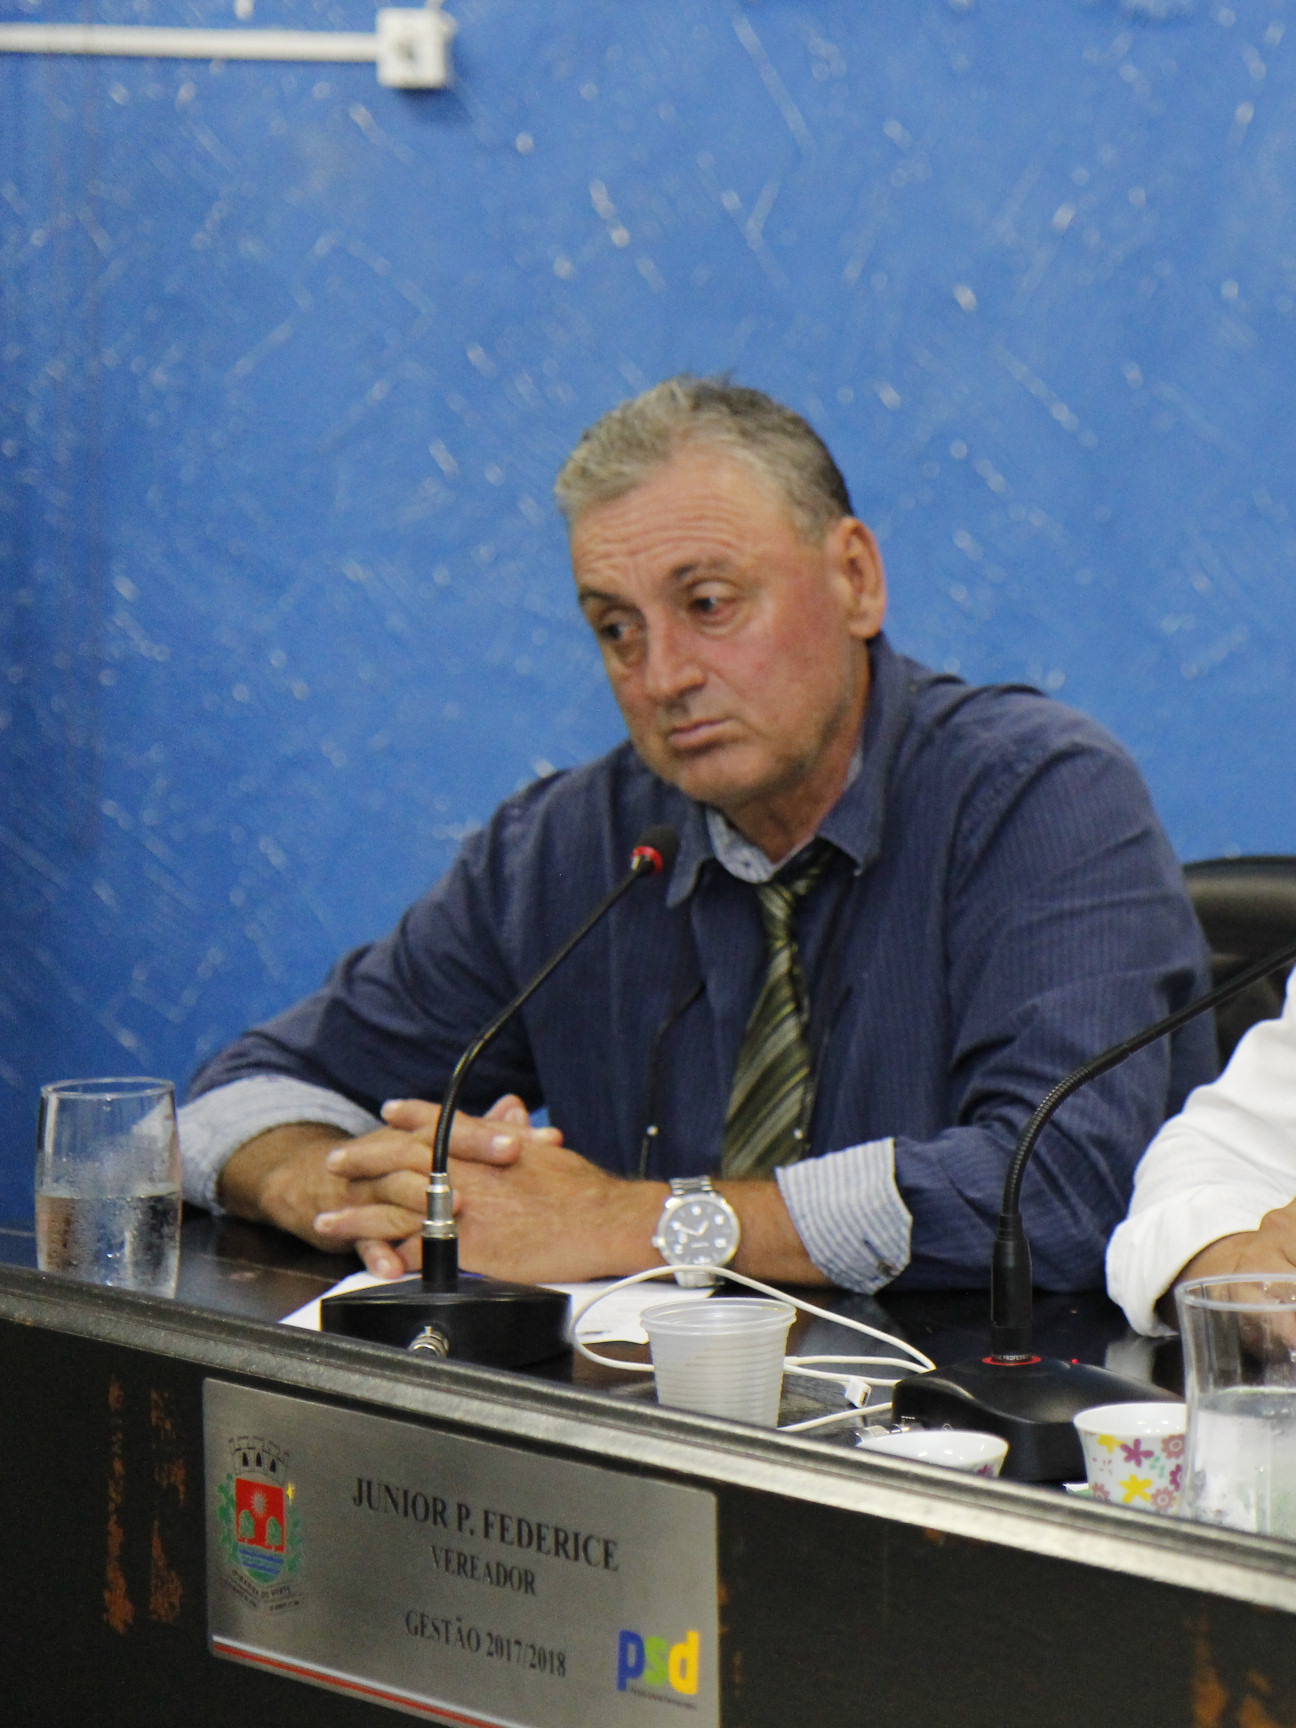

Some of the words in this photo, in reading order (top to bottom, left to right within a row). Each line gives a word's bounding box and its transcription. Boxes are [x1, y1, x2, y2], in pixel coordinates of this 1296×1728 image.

[352, 1477, 448, 1529] JUNIOR
[457, 1502, 475, 1537] P.
[483, 1509, 620, 1572] FEDERICE
[432, 1545, 536, 1595] VEREADOR
[405, 1609, 481, 1653] GESTÃO
[486, 1631, 566, 1677] 2017/2018
[617, 1629, 700, 1696] psd
